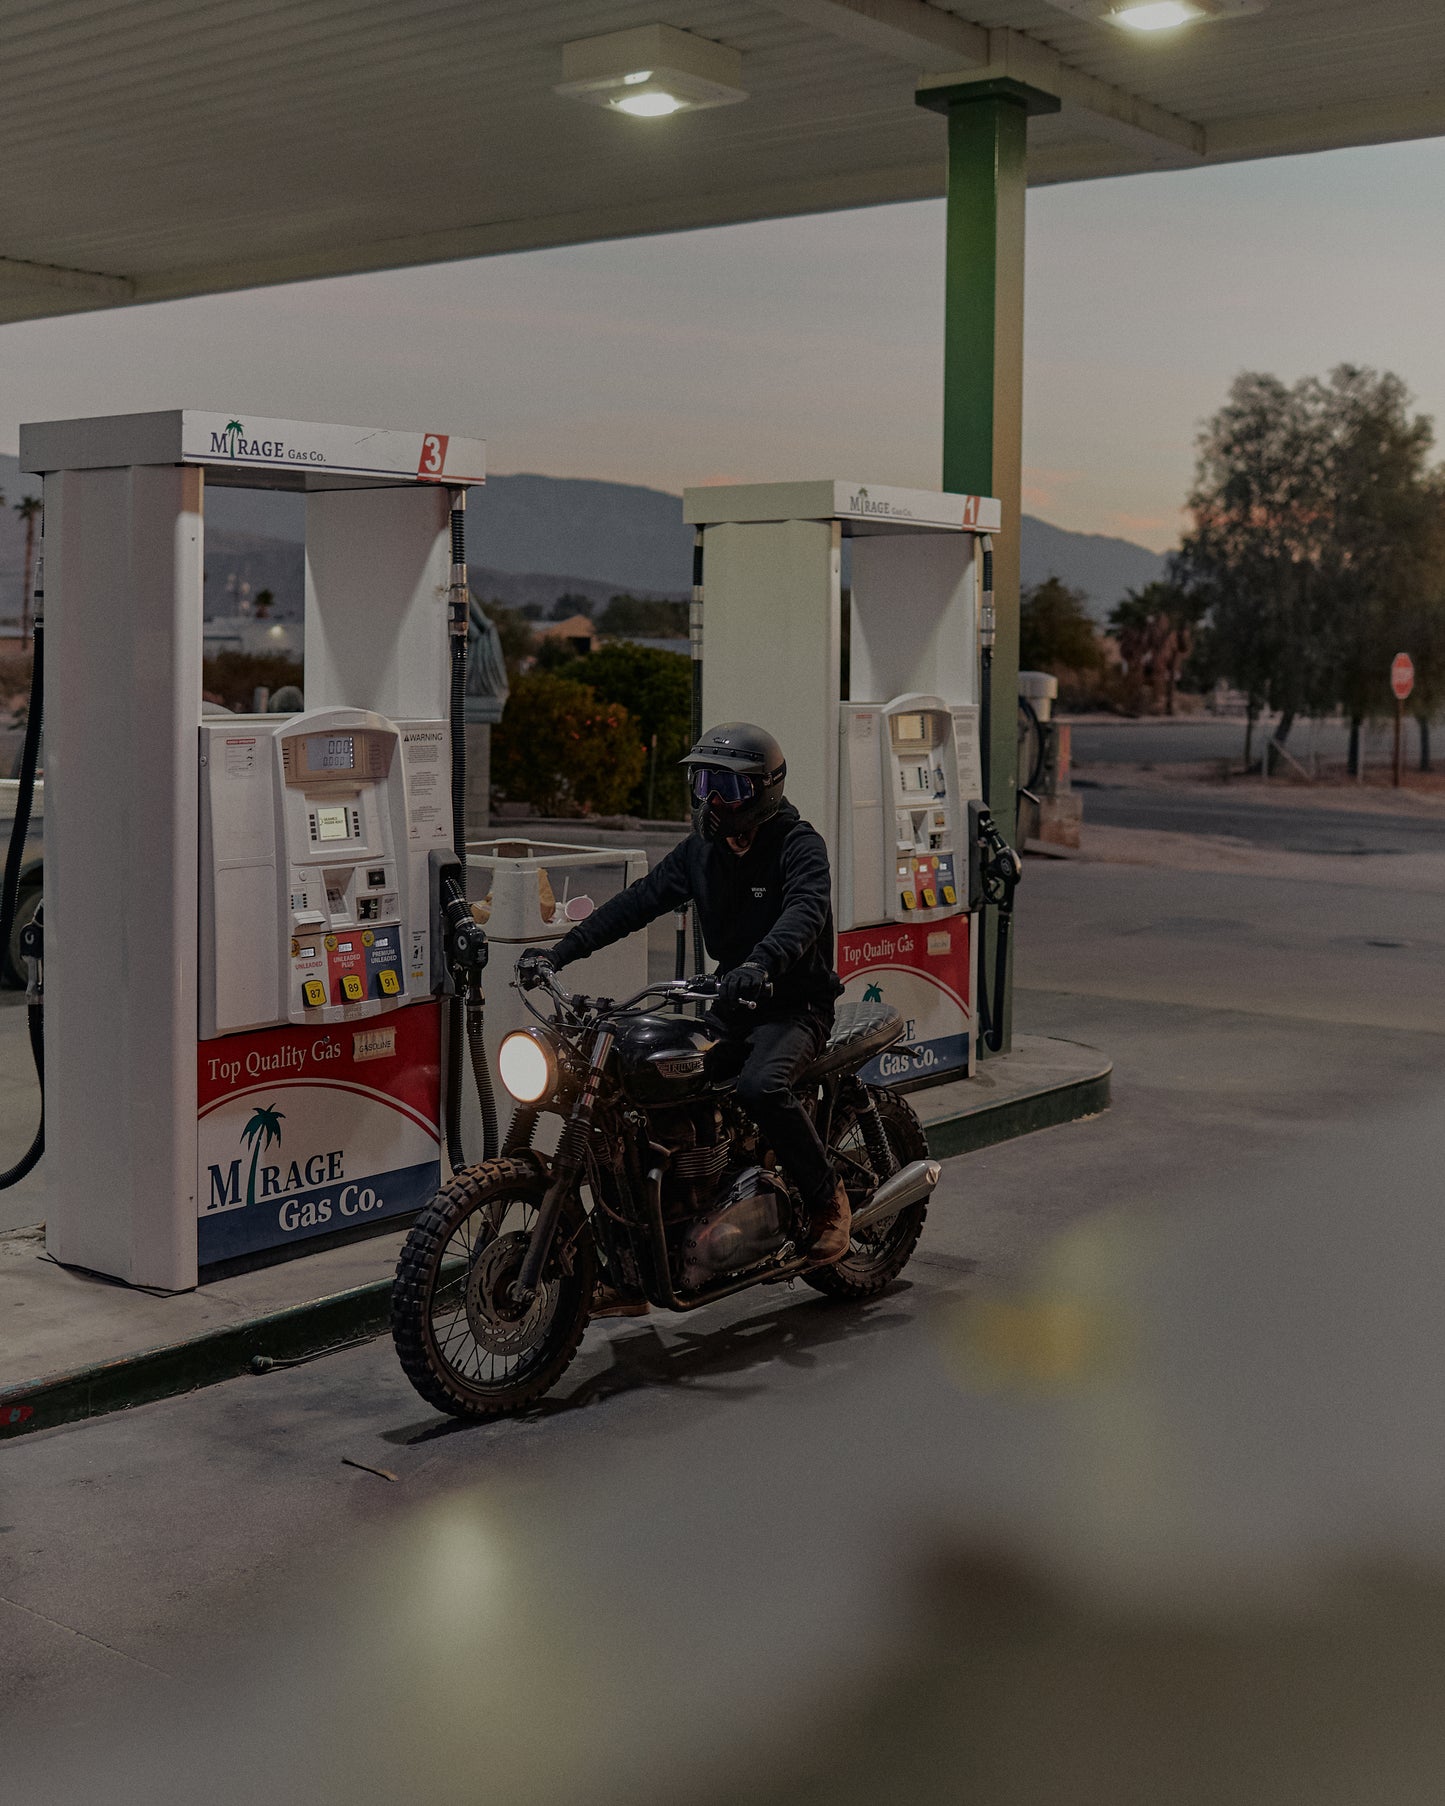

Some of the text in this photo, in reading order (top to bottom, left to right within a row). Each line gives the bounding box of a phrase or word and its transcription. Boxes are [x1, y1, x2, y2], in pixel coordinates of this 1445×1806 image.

[424, 436, 442, 473] 3
[966, 497, 976, 524] 1
[409, 733, 443, 741] WARNING
[372, 948, 395, 957] PREMIUM
[843, 945, 861, 966] Top
[863, 939, 896, 962] Quality
[897, 935, 915, 953] Gas
[333, 953, 361, 964] UNLEADED
[370, 954, 398, 964] UNLEADED
[295, 961, 323, 970] UNLEADED
[347, 982, 359, 993] 89
[384, 977, 396, 988] 91
[310, 988, 321, 999] 87
[359, 1039, 392, 1053] GASOLINE
[207, 1039, 342, 1084] Top Quality Gas
[879, 1045, 940, 1077] Gas Co.
[278, 1184, 384, 1232] Gas Co.
